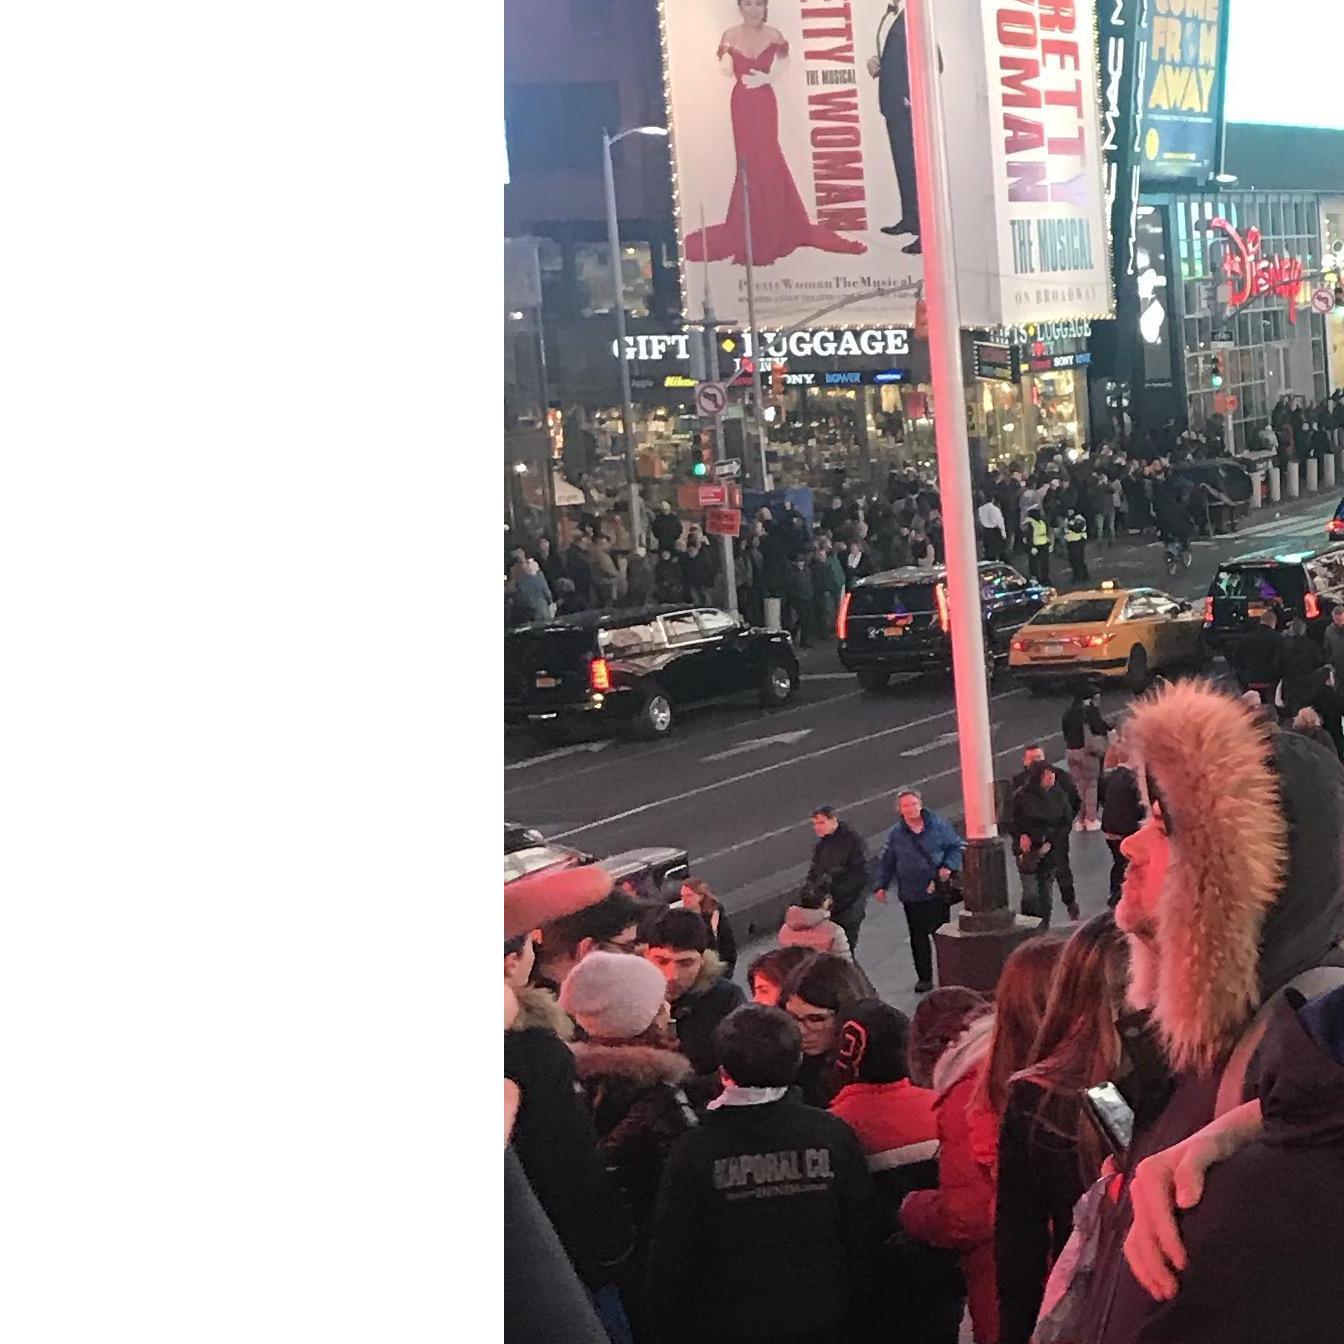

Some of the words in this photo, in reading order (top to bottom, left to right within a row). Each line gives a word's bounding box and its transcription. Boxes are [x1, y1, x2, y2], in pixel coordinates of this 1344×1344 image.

[806, 70, 819, 86] THE
[822, 68, 857, 85] MUSICAL
[1148, 64, 1215, 113] AWAY
[808, 88, 869, 232] WOMAN
[1010, 219, 1035, 274] THE
[1037, 218, 1095, 273] MUSICAL
[1036, 318, 1092, 341] LUGGAGE
[742, 330, 909, 357] LUGGAGE
[1053, 355, 1075, 367] SONY
